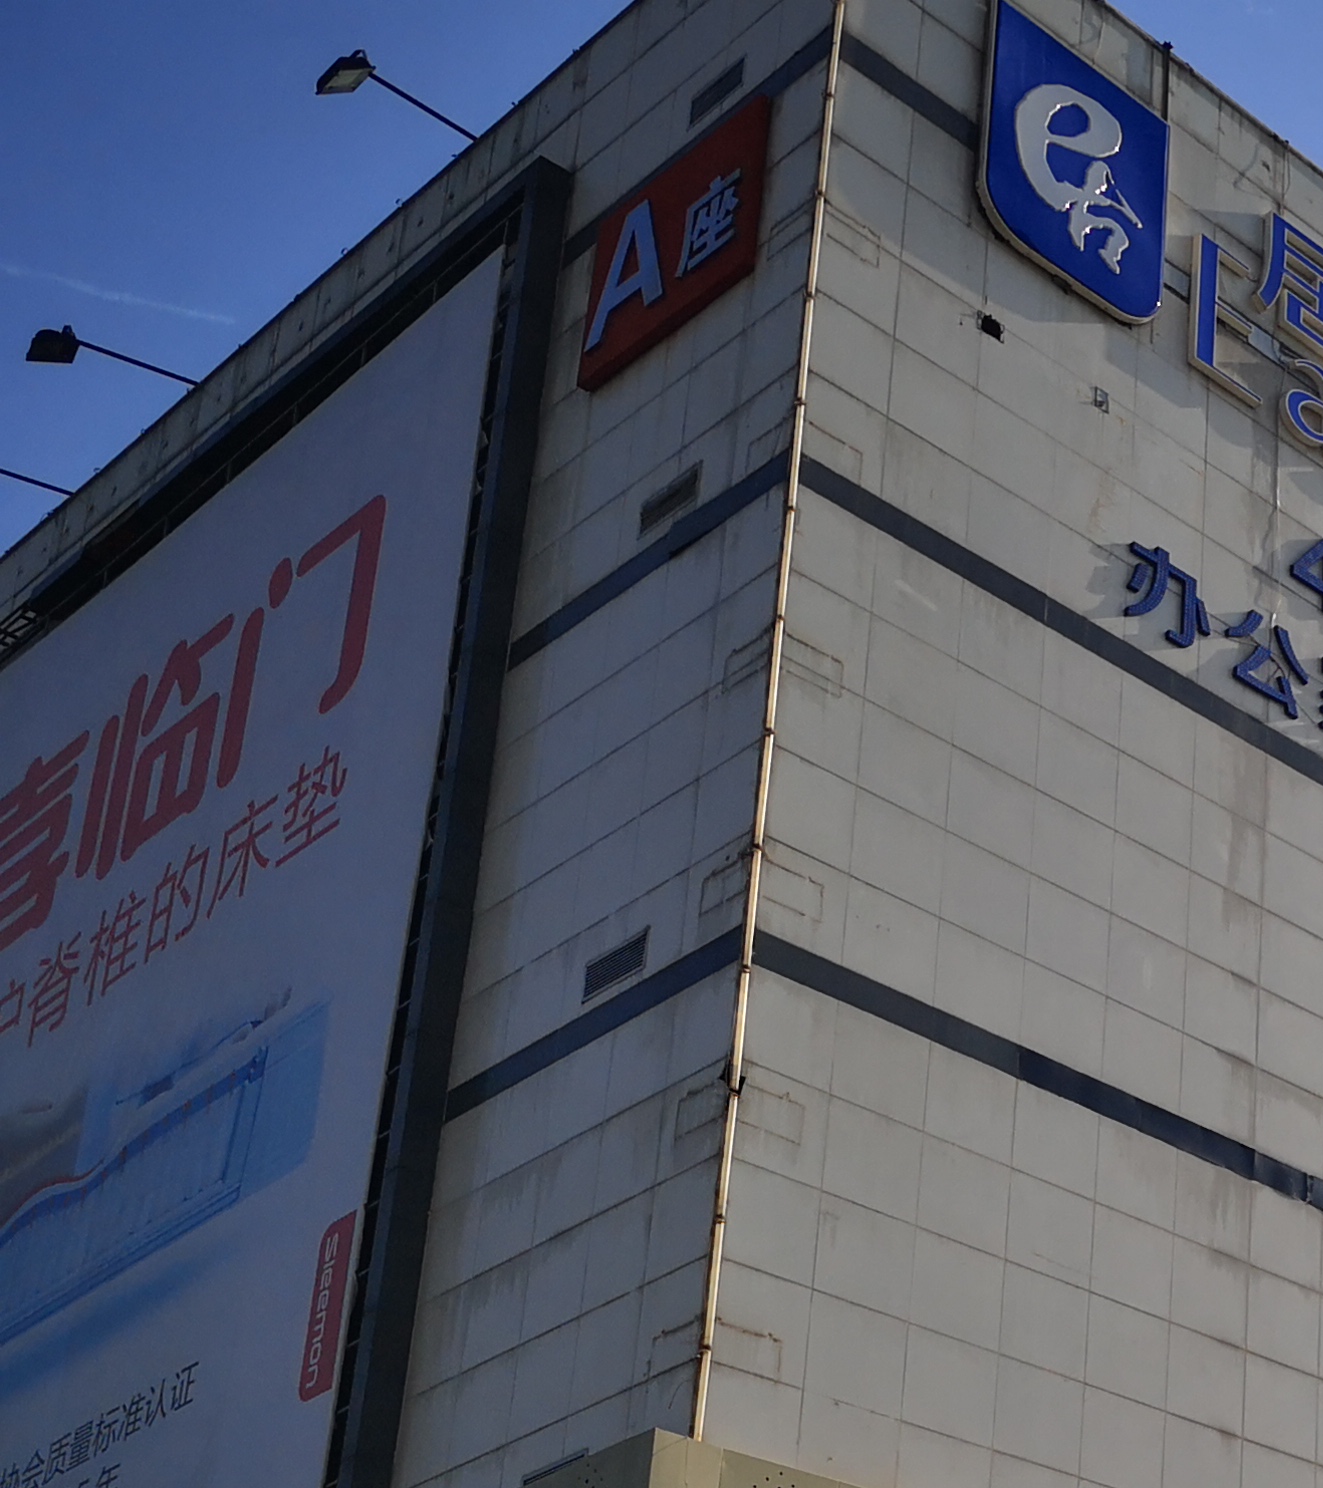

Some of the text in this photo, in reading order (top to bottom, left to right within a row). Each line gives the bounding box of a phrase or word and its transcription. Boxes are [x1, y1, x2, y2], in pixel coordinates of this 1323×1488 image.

[585, 166, 741, 353] A座
[0, 495, 386, 950] 喜临门
[306, 1232, 341, 1391] Sleemon
